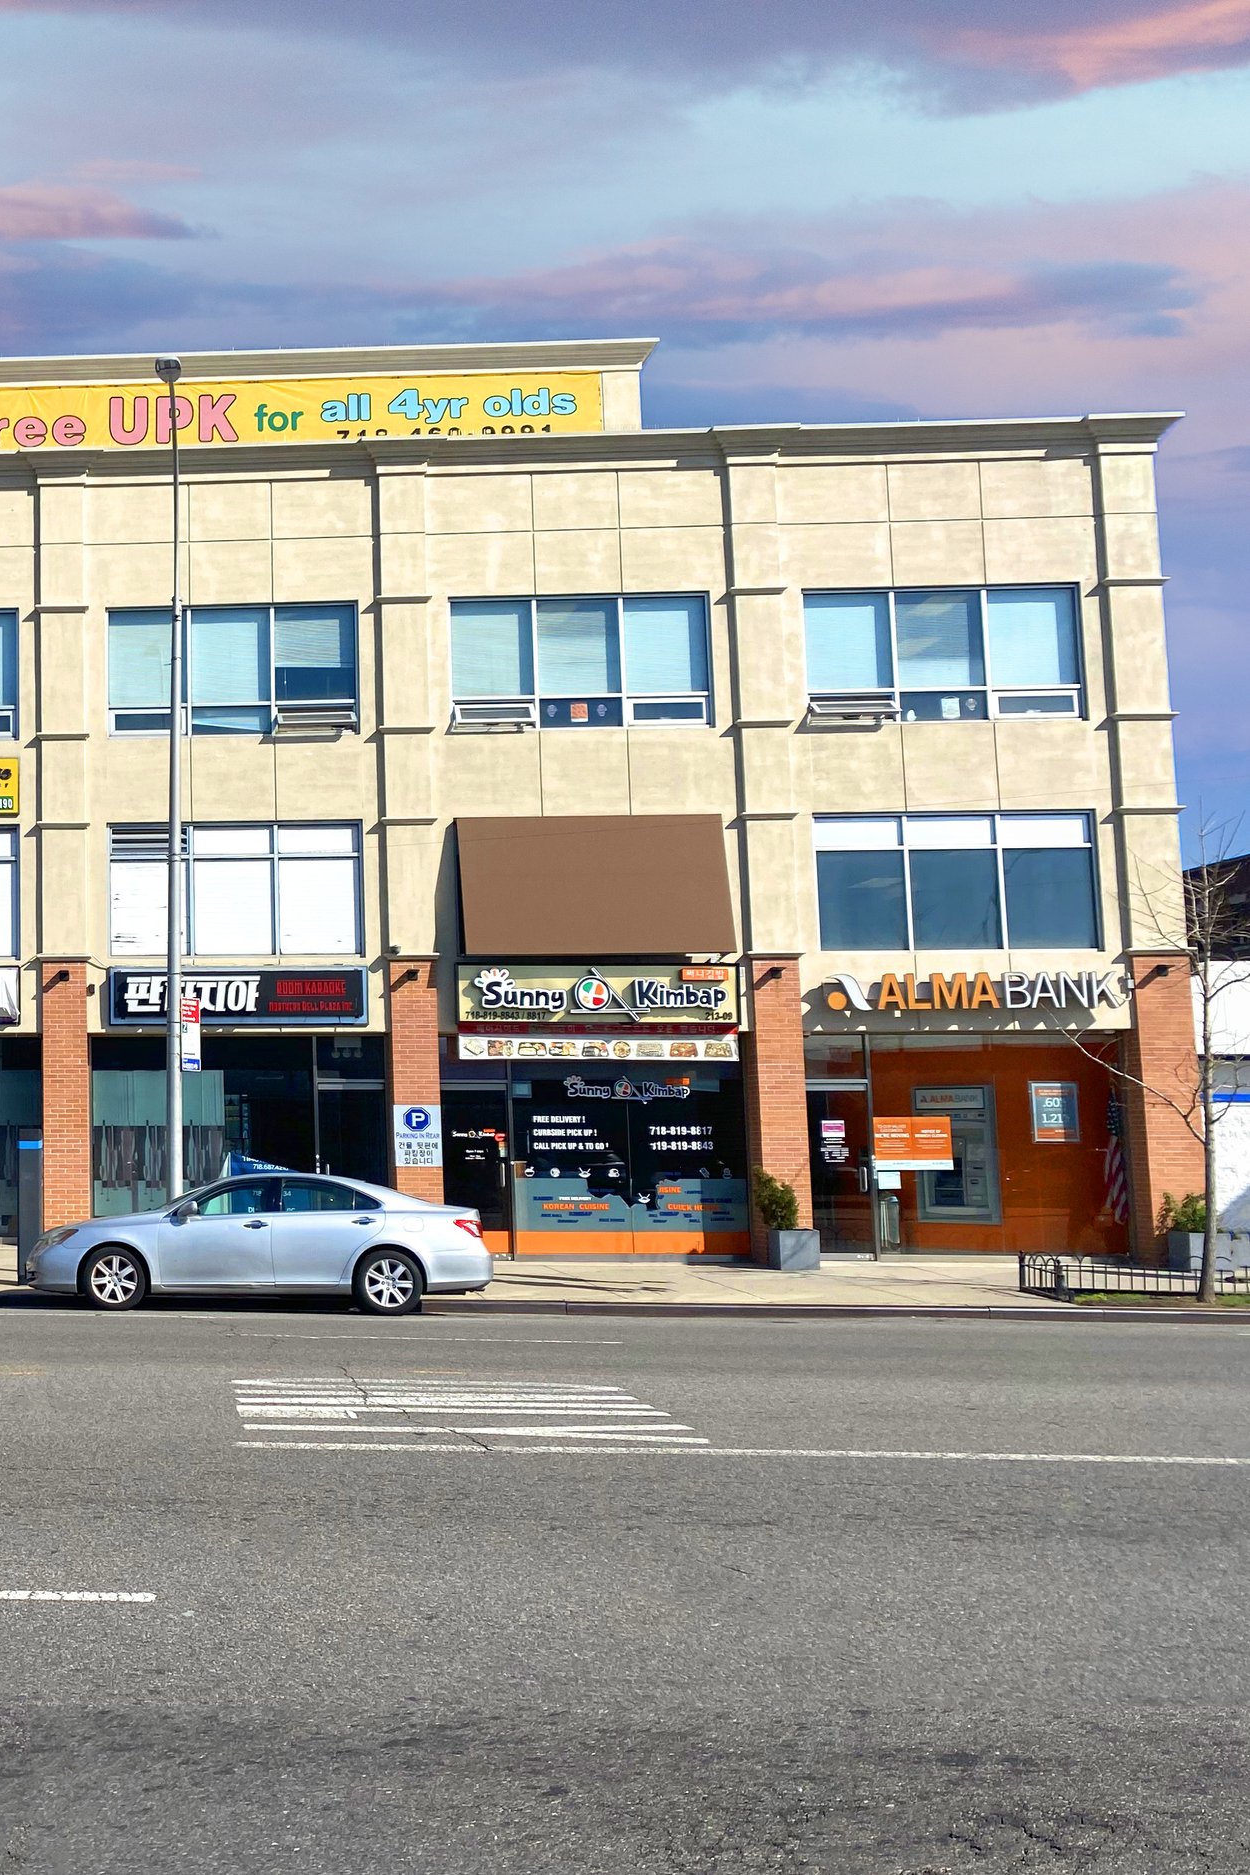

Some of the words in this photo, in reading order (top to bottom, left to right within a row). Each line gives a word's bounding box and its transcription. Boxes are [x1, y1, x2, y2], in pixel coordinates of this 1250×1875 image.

[109, 394, 239, 446] UPK
[254, 403, 304, 433] for
[320, 393, 371, 423] all
[388, 388, 468, 424] 4yr
[483, 387, 578, 418] olds
[276, 981, 303, 995] ROOM
[305, 981, 347, 995] KARAOKE
[483, 979, 566, 1010] Sunny
[634, 977, 728, 1009] Kimbap
[878, 973, 1000, 1010] ALMA
[1001, 971, 1120, 1010] BANK
[567, 1081, 611, 1099] Sunny
[642, 1081, 691, 1099] Kimbap
[411, 1112, 426, 1127] P
[532, 1115, 550, 1123] FREE
[550, 1115, 581, 1123] DELIVERY
[533, 1128, 566, 1136] CURBSIDE
[566, 1128, 583, 1136] PICK
[583, 1128, 593, 1136] UP
[649, 1126, 713, 1135] 718-819-8817
[533, 1142, 550, 1150] CALL
[551, 1142, 567, 1150] PICK
[567, 1142, 577, 1150] UP
[585, 1142, 594, 1150] TO
[595, 1142, 605, 1150] GO
[404, 1157, 434, 1165] 있습니다
